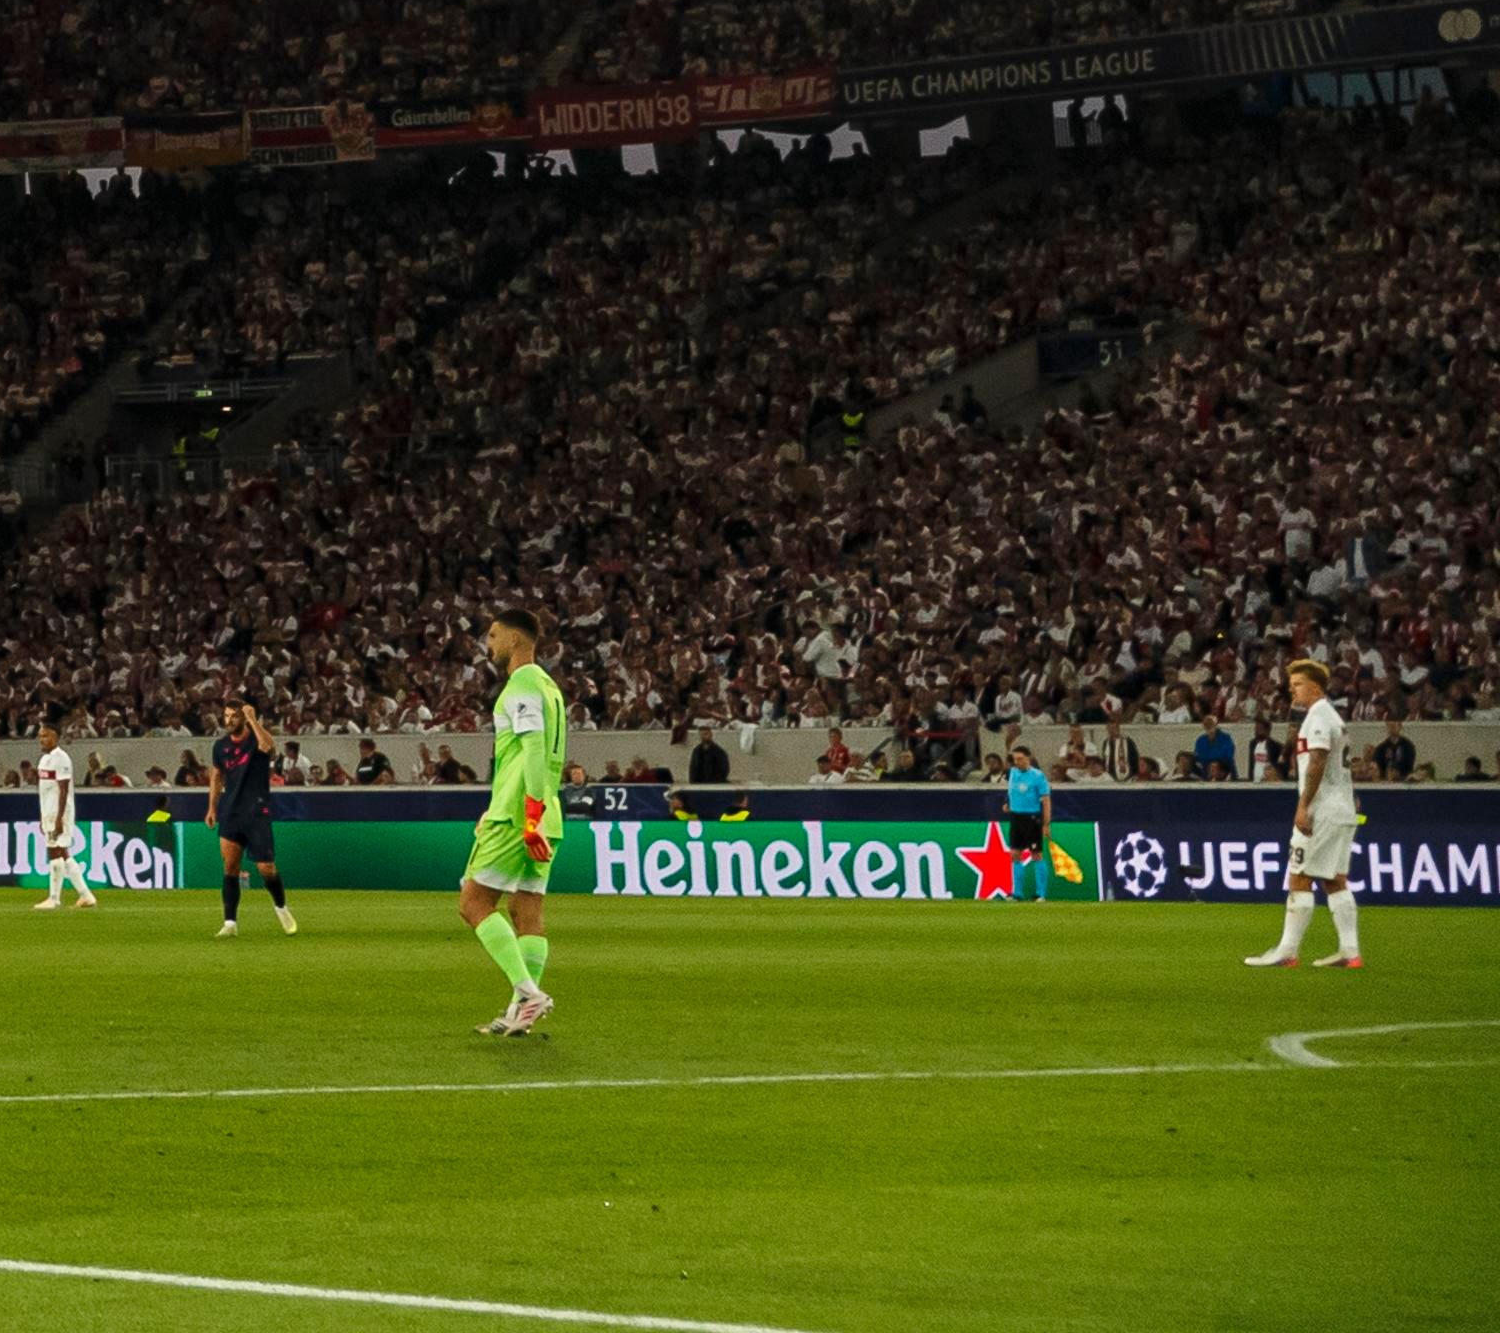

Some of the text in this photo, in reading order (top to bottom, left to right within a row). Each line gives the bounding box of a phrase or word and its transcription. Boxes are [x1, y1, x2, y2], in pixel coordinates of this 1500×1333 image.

[843, 76, 905, 106] UEFA
[911, 61, 1052, 100] CHAMPIONS
[1060, 48, 1157, 83] LEAGUE
[605, 788, 628, 811] 52
[590, 820, 953, 900] Heineken
[1179, 840, 1318, 893] UEF
